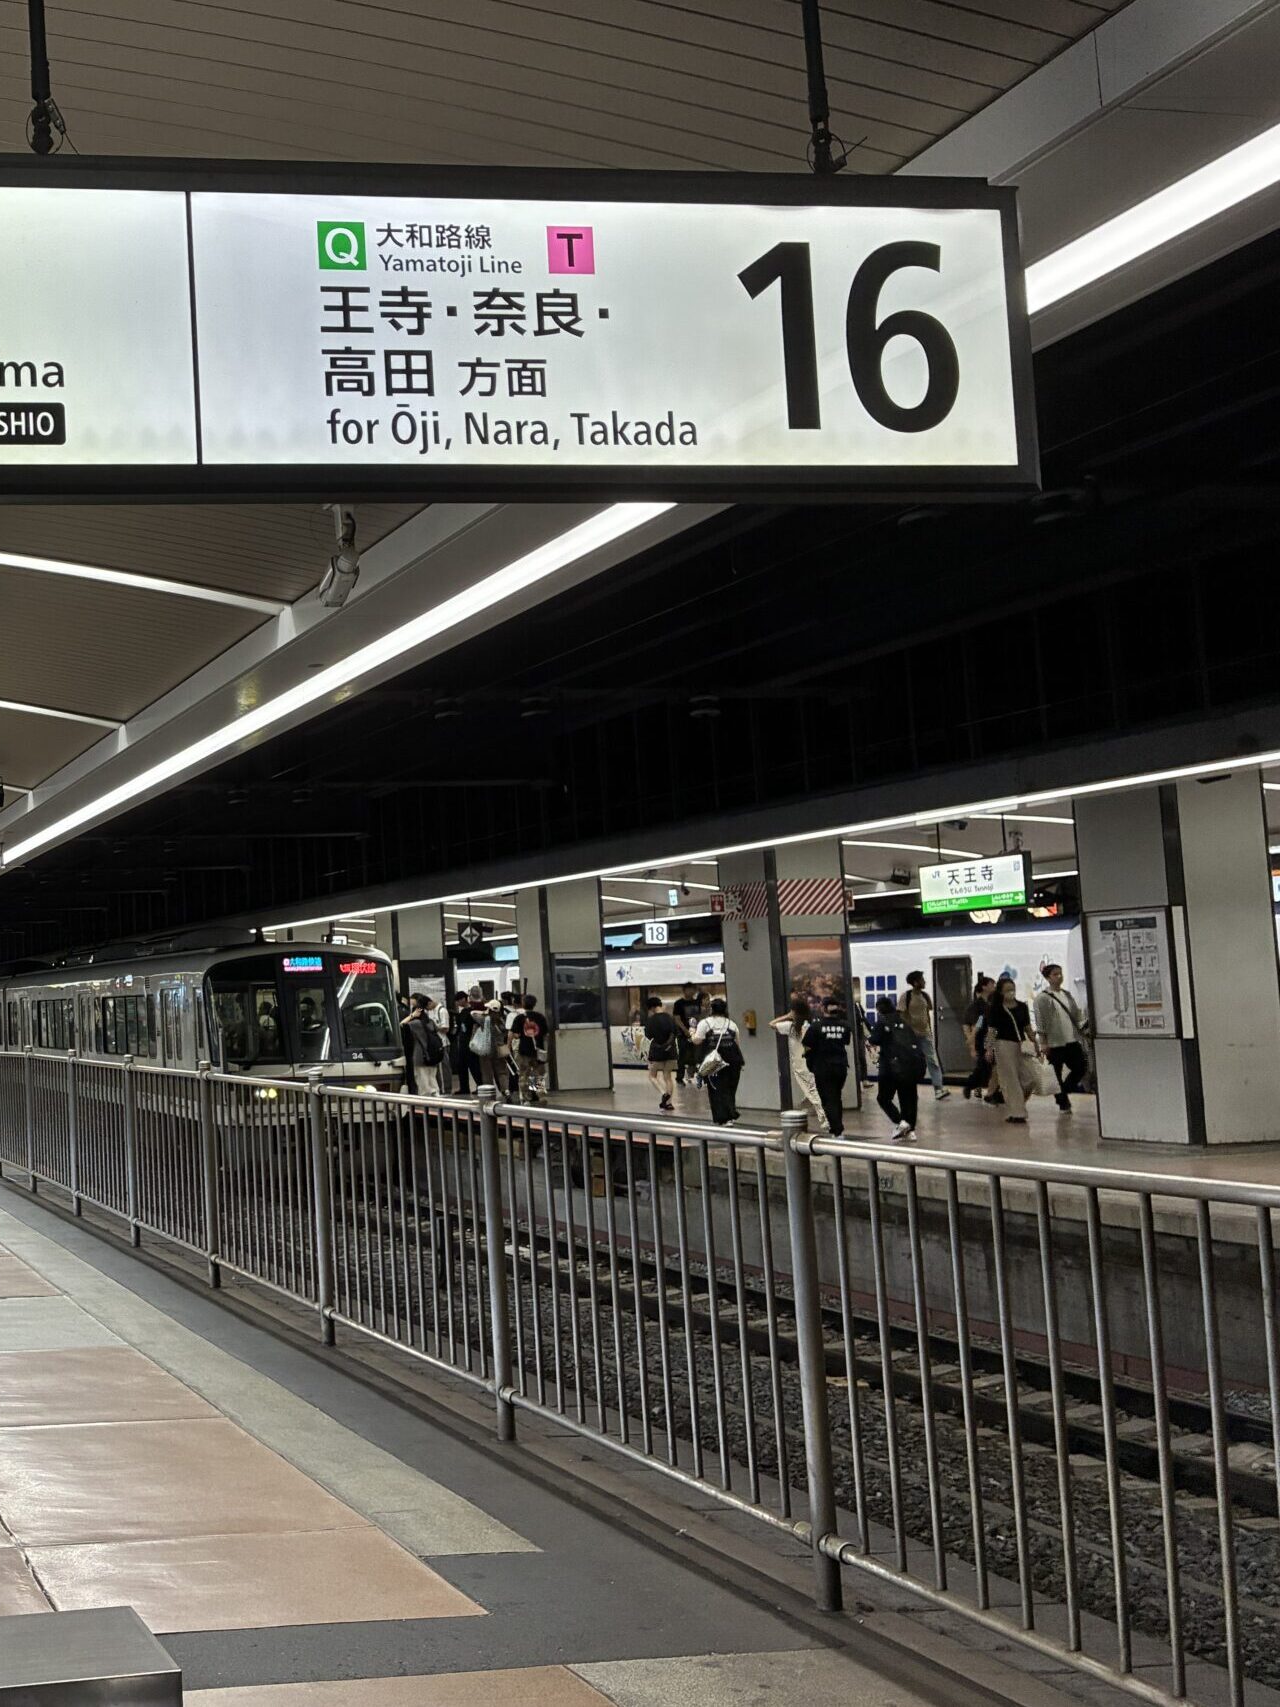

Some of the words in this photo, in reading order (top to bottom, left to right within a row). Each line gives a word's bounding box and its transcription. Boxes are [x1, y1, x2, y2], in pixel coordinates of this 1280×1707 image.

[324, 226, 360, 267] Q
[375, 223, 493, 252] 大和路線
[557, 234, 584, 268] T
[379, 254, 474, 278] Yamatoji
[480, 255, 523, 275] Line
[737, 239, 961, 434] 16
[323, 348, 435, 398] 高田
[457, 357, 549, 398] 方面
[327, 410, 380, 446] for
[391, 403, 453, 454] Ōji,
[463, 411, 561, 452] Nara,
[570, 411, 699, 447] Takada
[947, 864, 994, 886] 天王寺
[647, 926, 666, 942] 18
[351, 1051, 364, 1060] 34
